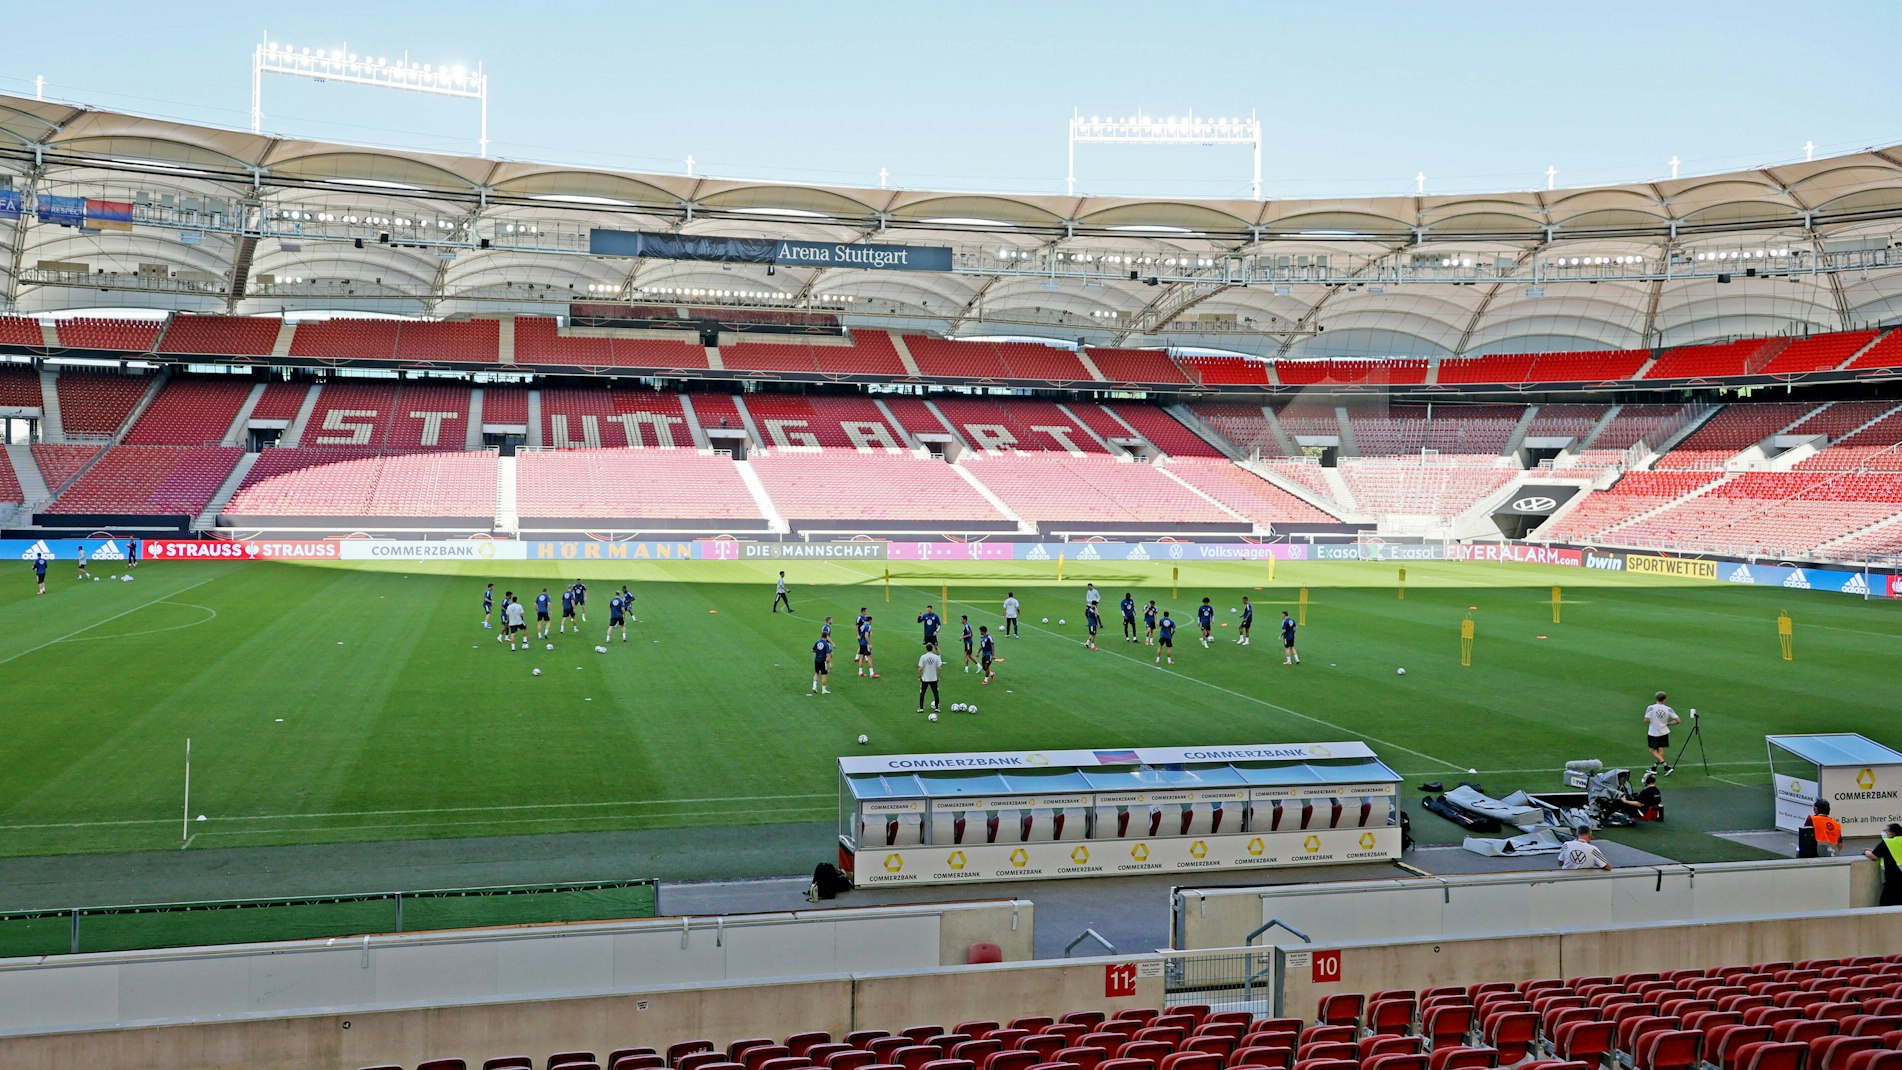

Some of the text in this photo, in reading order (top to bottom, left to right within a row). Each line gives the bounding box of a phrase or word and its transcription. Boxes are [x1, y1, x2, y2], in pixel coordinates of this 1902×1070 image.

[51, 206, 82, 216] RESPECT
[778, 242, 908, 267] Arena Stuttgart
[166, 543, 241, 557] STRAUSS
[262, 543, 335, 557] STRAUSS
[371, 546, 474, 556] COMMERZBANK
[538, 541, 692, 559] HÖRMANN
[746, 545, 880, 557] DIE MANNSCHAFT
[1200, 546, 1272, 559] Volkswagen
[1391, 546, 1435, 559] Exasol
[1586, 552, 1622, 571] bwin
[1628, 557, 1715, 577] SPORTWETTEN
[1729, 575, 1755, 584] adidas
[1783, 580, 1811, 589] adidas
[1184, 749, 1306, 760] COMMERZBANK
[888, 757, 1022, 769] COMMERZBANK
[1778, 789, 1814, 801] COMMERZBANK
[1834, 790, 1898, 801] COMMERZBANK
[1841, 816, 1858, 824] Bank
[1235, 857, 1277, 865] COMMERZBANK
[1291, 854, 1333, 862] COMMERZBANK
[1347, 851, 1388, 859] COMMERZBANK
[1177, 860, 1220, 868] COMMERZBANK
[1316, 956, 1338, 976] 10
[1110, 971, 1130, 990] 11
